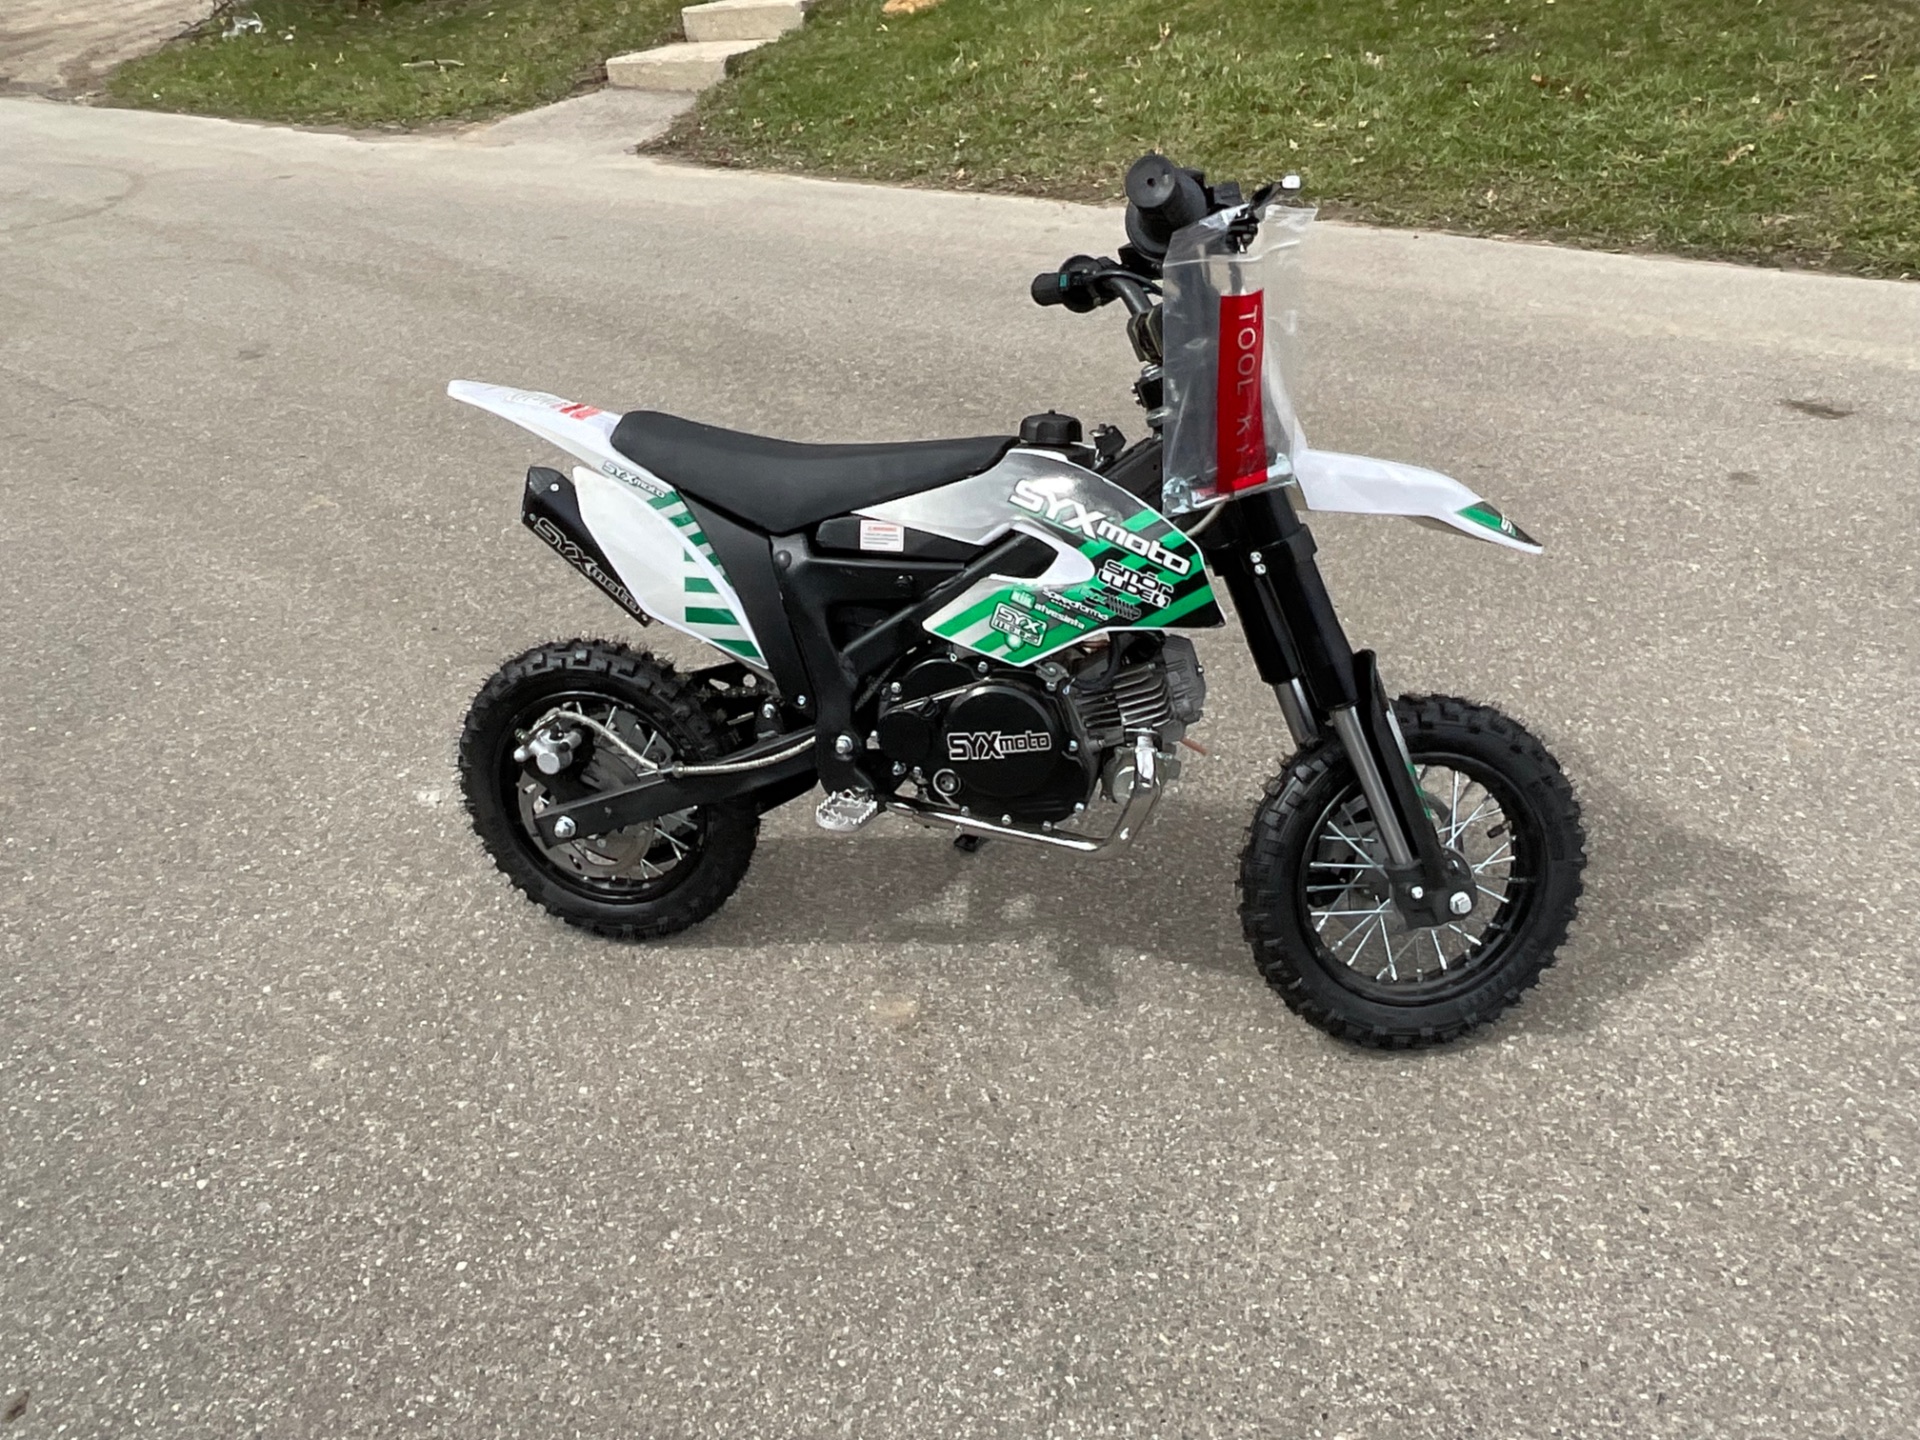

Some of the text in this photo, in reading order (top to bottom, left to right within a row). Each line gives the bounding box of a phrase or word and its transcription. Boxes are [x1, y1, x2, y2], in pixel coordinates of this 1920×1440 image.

[1236, 304, 1258, 397] TOOL
[1009, 479, 1191, 575] SYXmoto
[999, 606, 1039, 634] SYX
[947, 730, 1051, 760] SYXmoto
